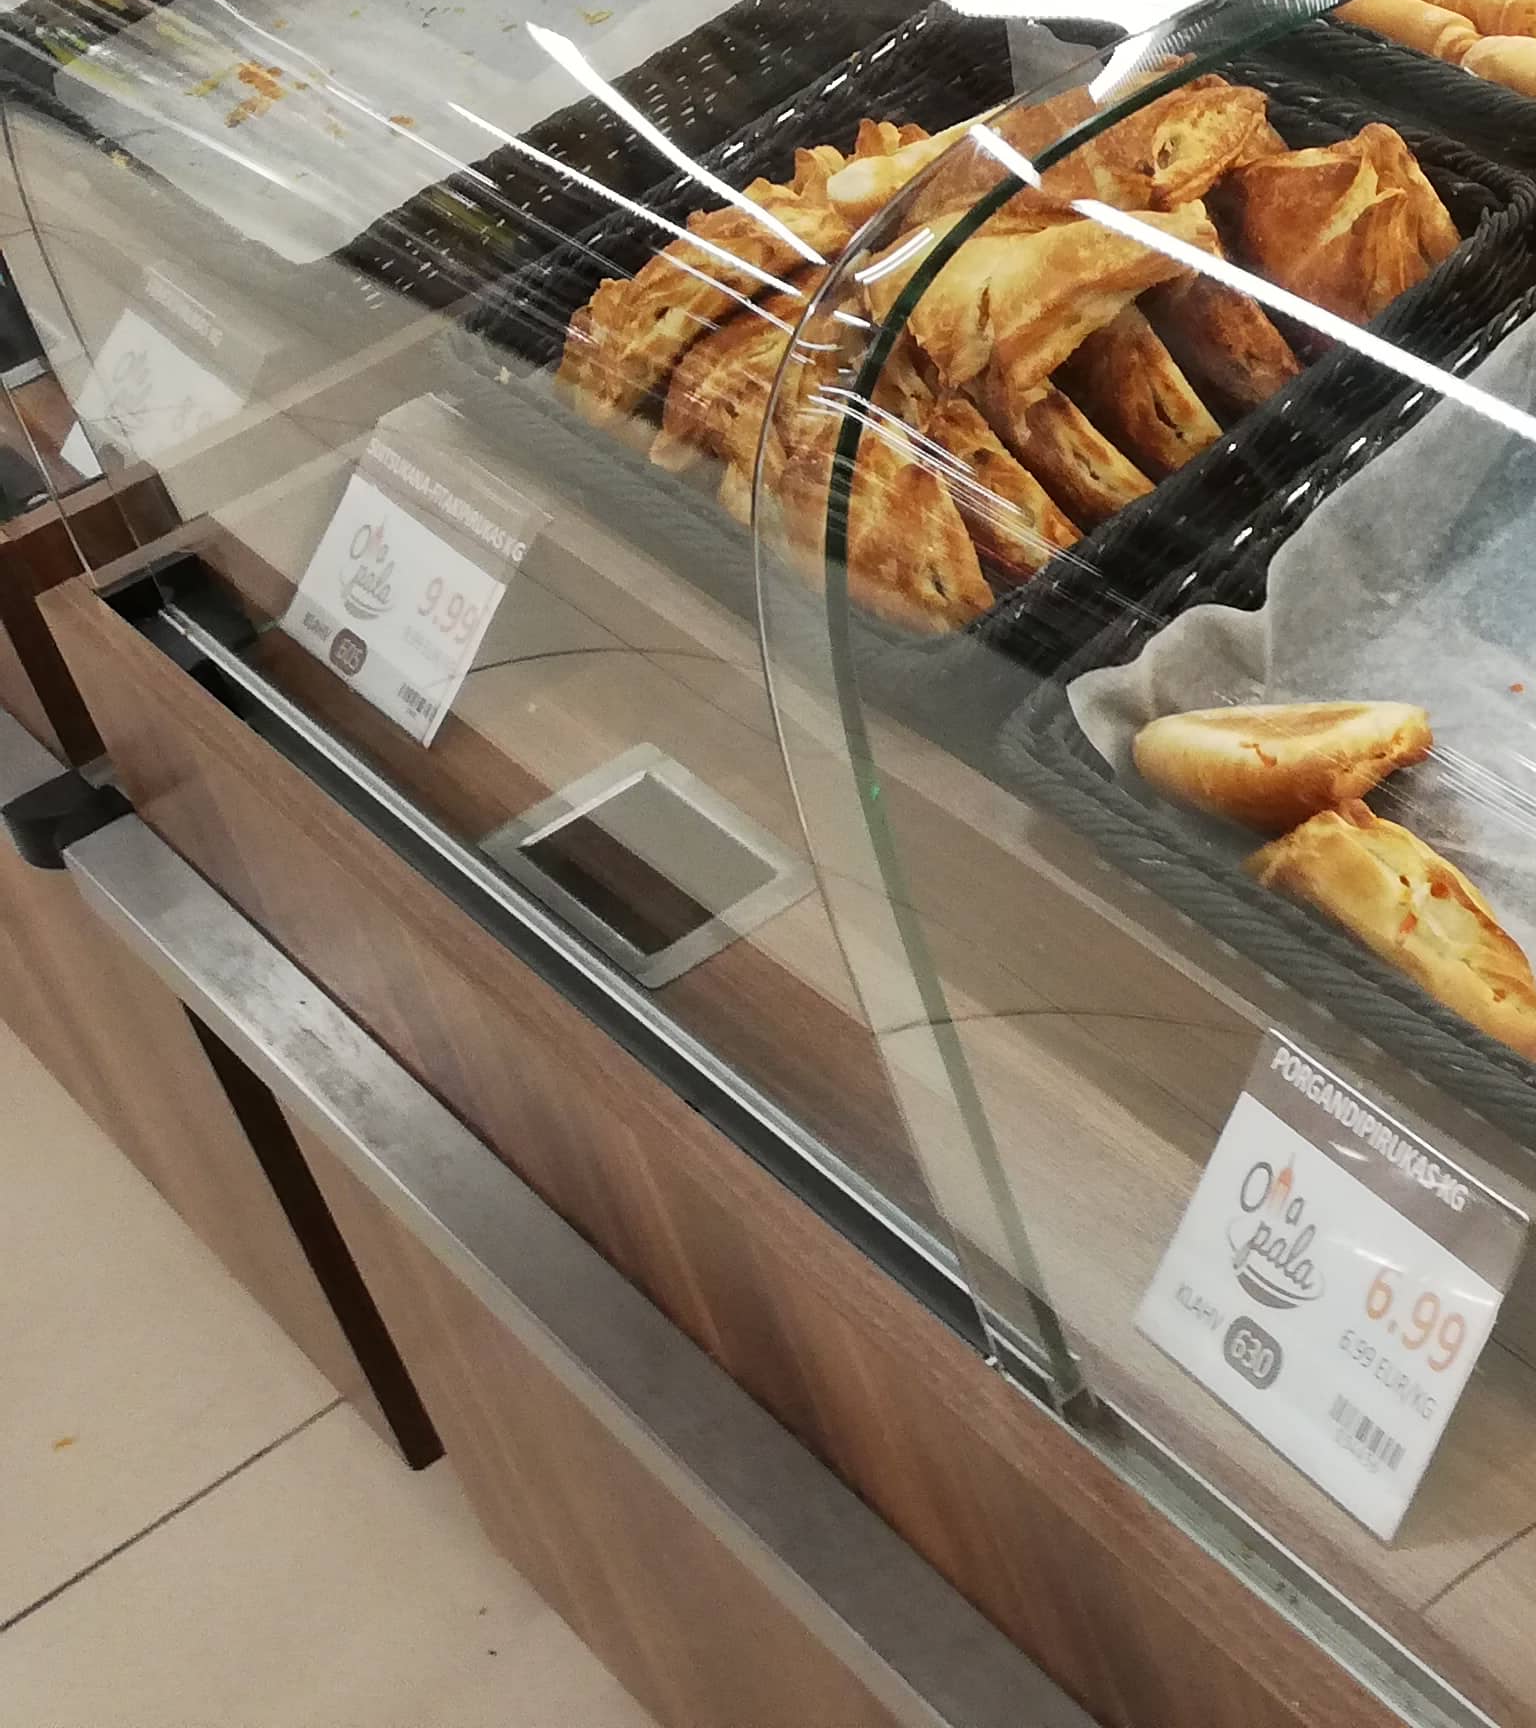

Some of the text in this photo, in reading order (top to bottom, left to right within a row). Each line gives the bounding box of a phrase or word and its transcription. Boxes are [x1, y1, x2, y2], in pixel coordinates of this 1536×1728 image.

[417, 575, 481, 644] 9.99
[1269, 1046, 1469, 1212] PORGANDIPIRUKAS KG
[1232, 1216, 1319, 1292] pala
[1174, 1280, 1226, 1334] KLAHV
[1363, 1267, 1467, 1374] 6.99
[1229, 1329, 1272, 1381] 630
[1338, 1327, 1438, 1420] 6.99 EUR/KG
